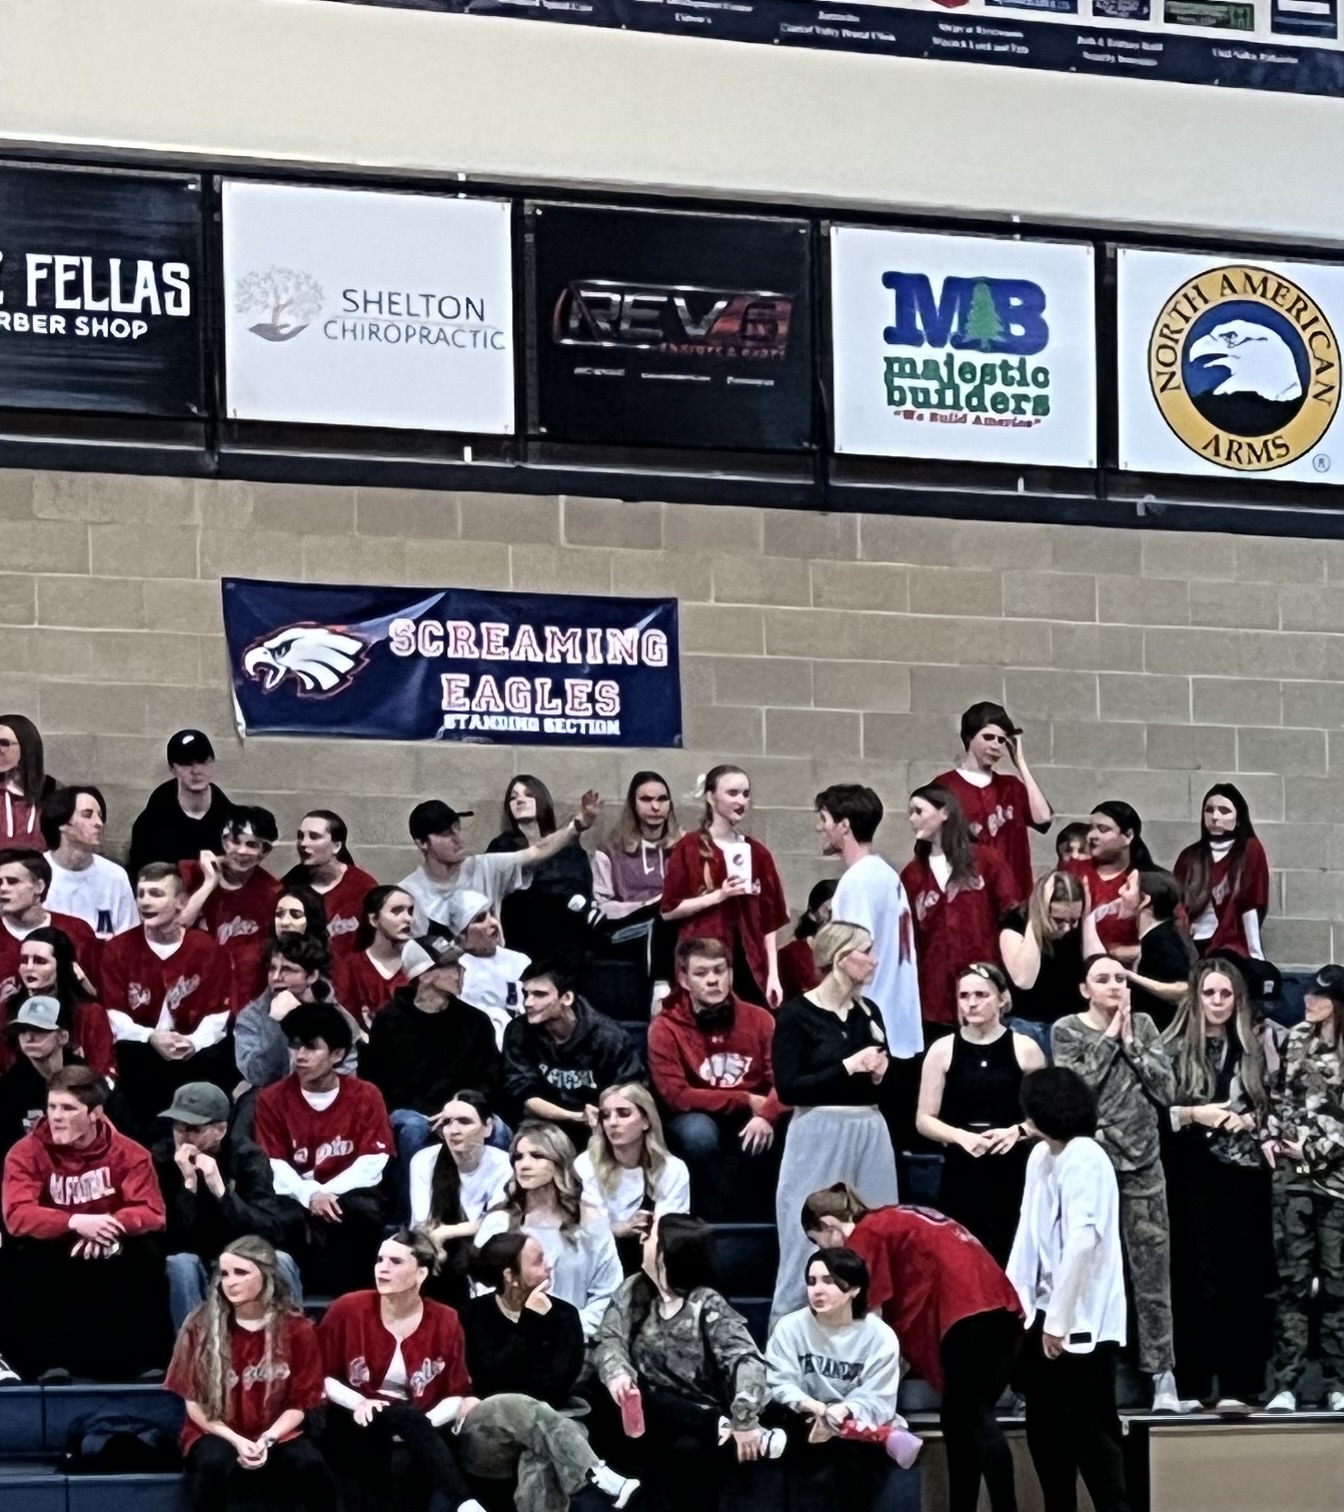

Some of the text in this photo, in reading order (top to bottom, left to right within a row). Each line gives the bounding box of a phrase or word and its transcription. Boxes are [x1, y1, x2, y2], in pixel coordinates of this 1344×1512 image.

[26, 253, 190, 317] FELLAS
[342, 288, 485, 322] SHELTON
[881, 271, 1050, 355] MB
[75, 316, 148, 339] SHOP
[323, 319, 506, 350] CHIROPRACTIC
[1156, 270, 1337, 408] NORTH AMERICAN
[883, 352, 1050, 388] majestic
[884, 382, 1051, 416] builders
[1202, 433, 1291, 466] ARMS
[389, 619, 668, 667] SCREAMING
[441, 673, 621, 717] EAGLES
[444, 713, 621, 735] STANDING SECTION
